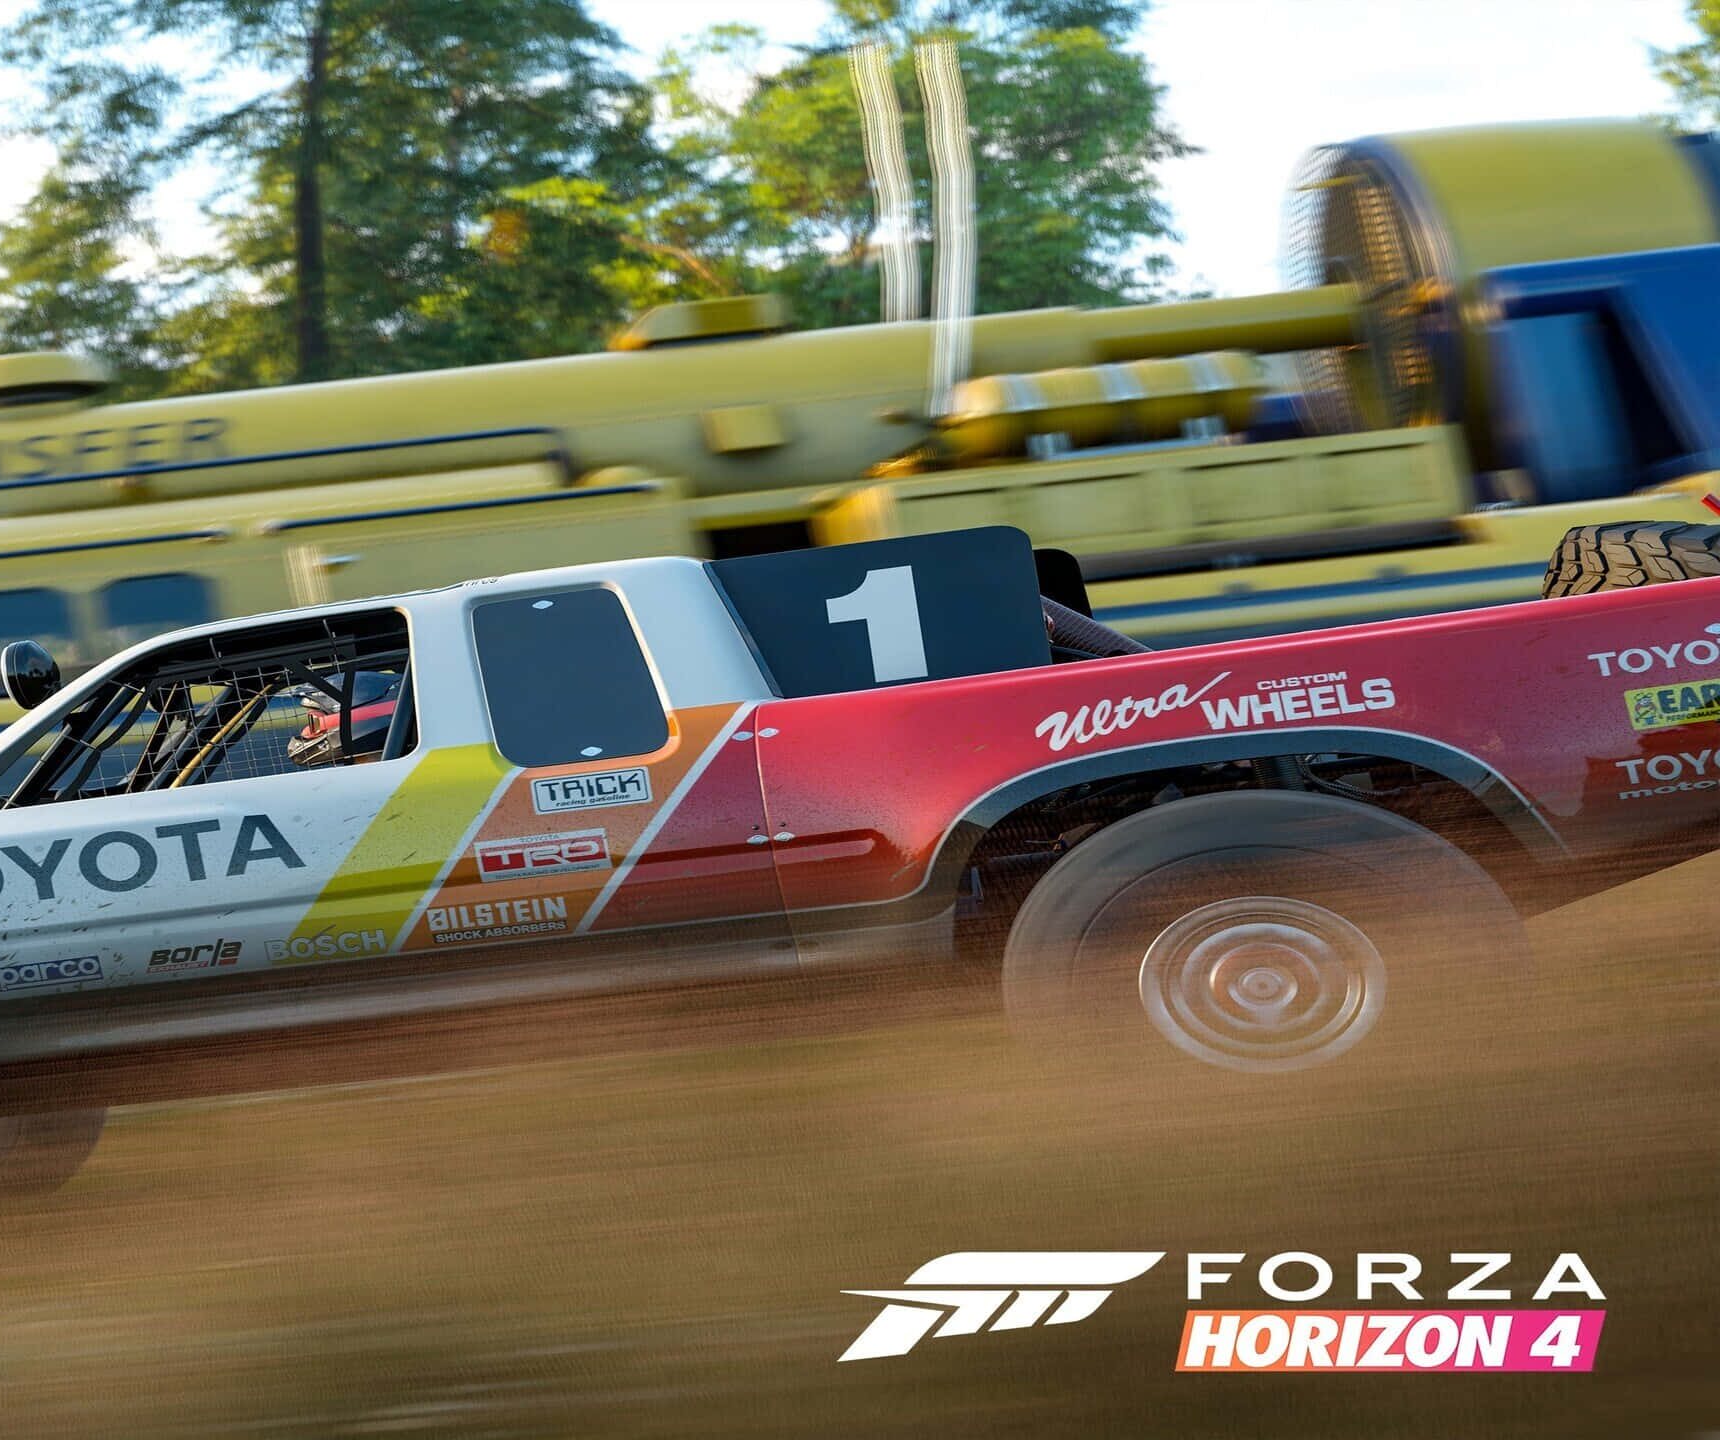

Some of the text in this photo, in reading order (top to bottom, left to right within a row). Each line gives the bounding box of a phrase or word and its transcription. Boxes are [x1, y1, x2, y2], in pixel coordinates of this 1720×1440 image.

[826, 565, 929, 683] 1
[1587, 638, 1720, 677] TOYO
[1257, 671, 1347, 691] CUSTOM
[1035, 671, 1232, 752] Ultra
[1200, 677, 1396, 731] WHEELS
[540, 773, 641, 801] TRICK
[556, 793, 631, 808] racing gasoline
[1619, 779, 1720, 800] moto
[519, 833, 560, 844] TOYOTA
[485, 840, 599, 869] TRD
[427, 896, 567, 931] BILSTEIN
[264, 929, 387, 961] BOSCH
[435, 921, 567, 943] SHOCK ABSORBERS
